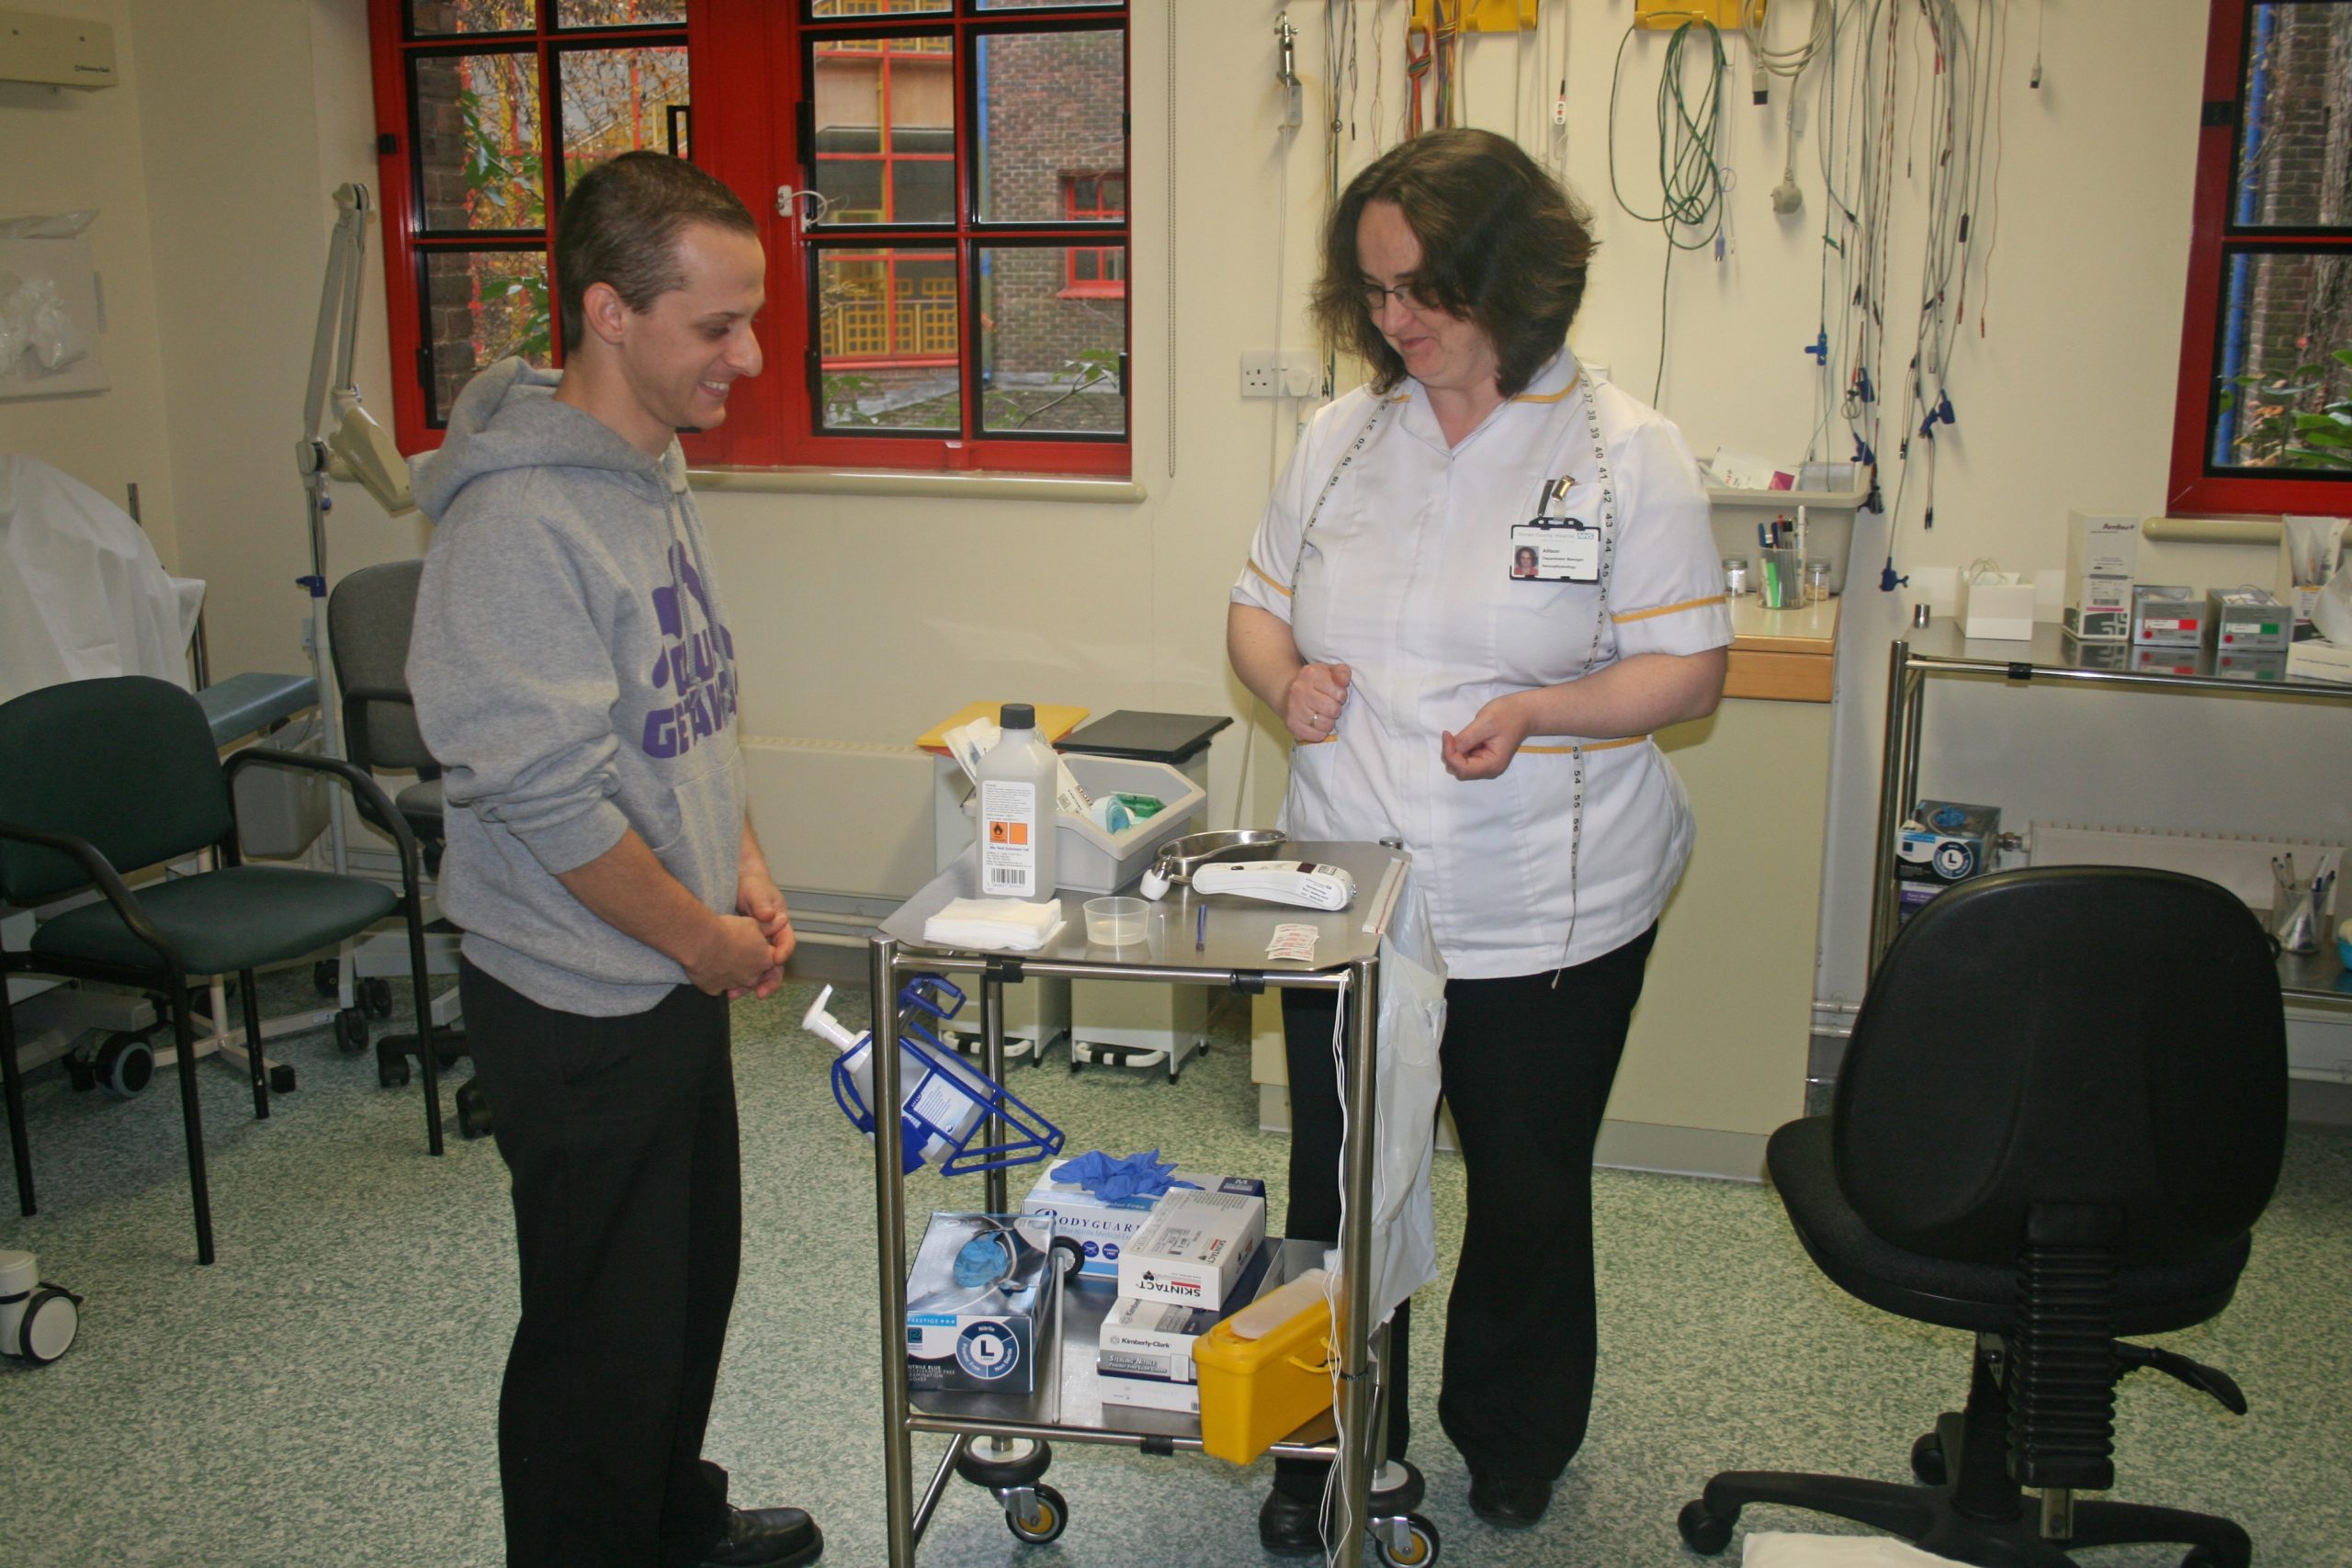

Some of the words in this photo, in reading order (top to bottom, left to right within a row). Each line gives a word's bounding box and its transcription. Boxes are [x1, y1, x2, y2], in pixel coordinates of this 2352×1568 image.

[1584, 393, 1593, 403] 37
[1587, 410, 1597, 421] 38
[1589, 427, 1600, 439] 39
[1353, 437, 1365, 450] 20
[1594, 446, 1604, 458] 40
[1341, 457, 1352, 467] 19
[1599, 467, 1608, 479] 41
[1603, 489, 1612, 503] 42
[1605, 513, 1613, 528] 43
[1605, 537, 1612, 552] 44
[1572, 746, 1579, 760] 53
[1574, 770, 1581, 784] 54
[1573, 794, 1581, 808] 55
[1572, 818, 1579, 832] 56
[1949, 852, 1958, 864] L
[1139, 1280, 1201, 1297] SKINTACT
[980, 1339, 995, 1357] L
[1121, 1337, 1170, 1348] Kimberly-Clark
